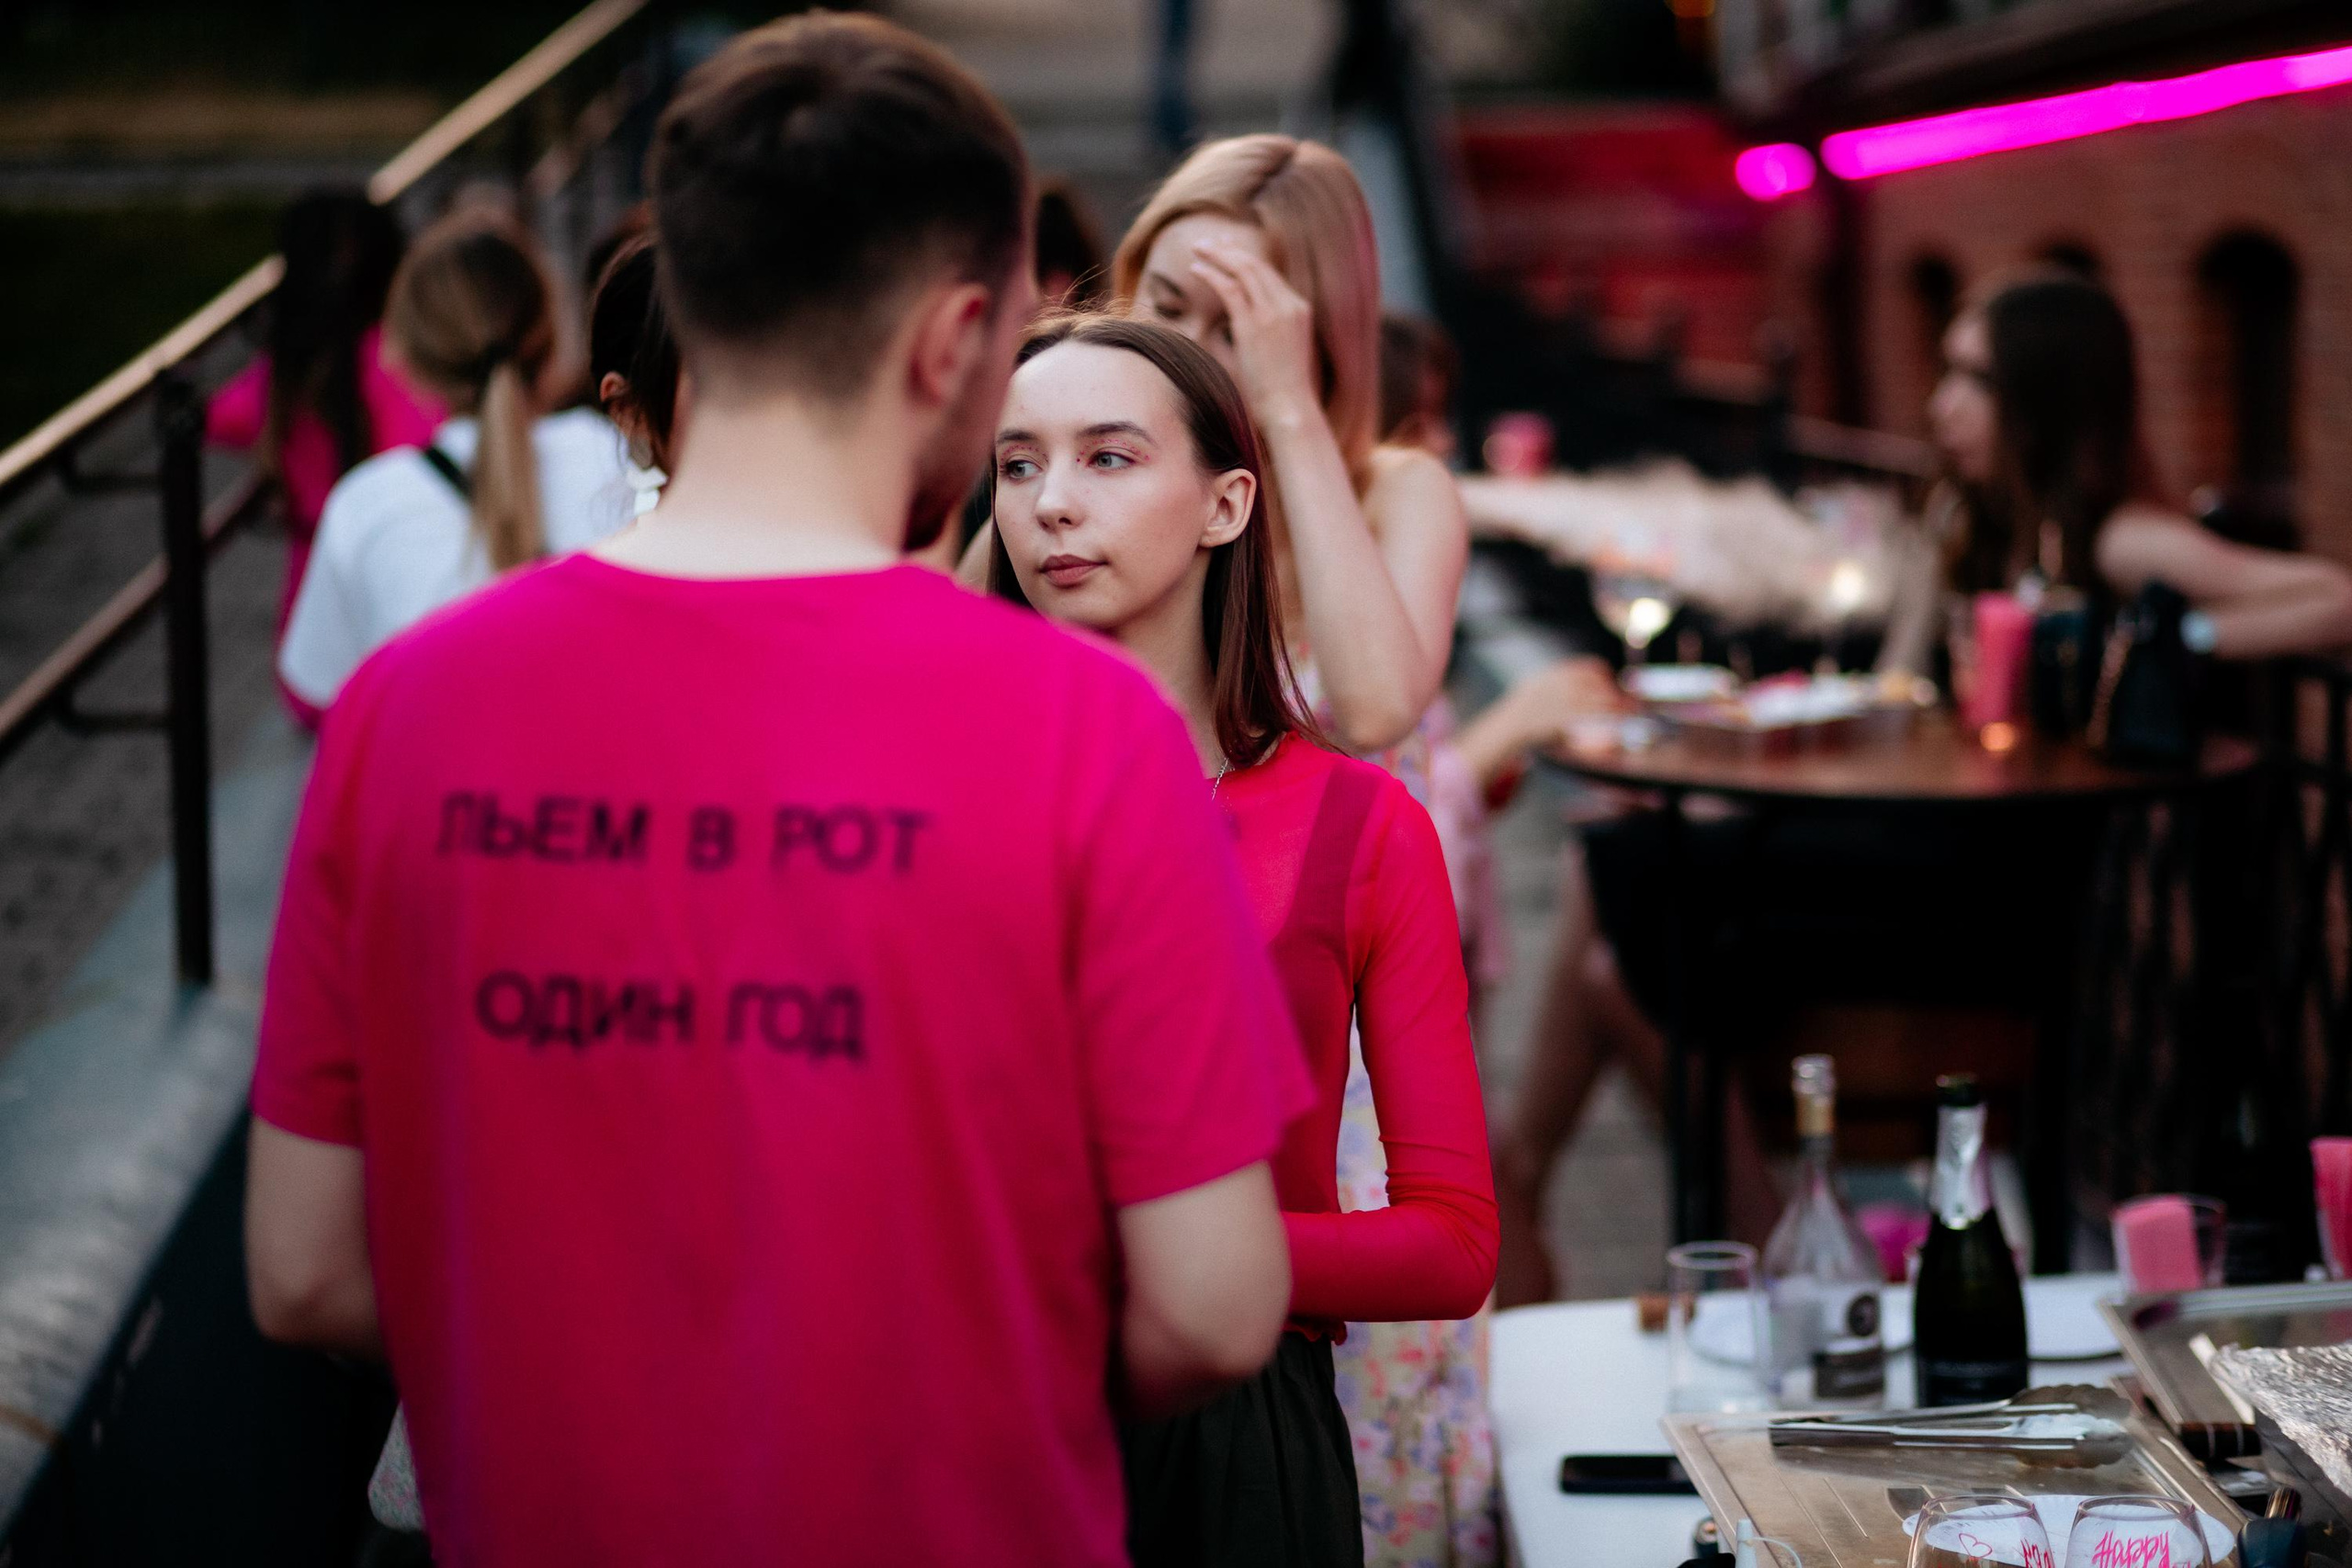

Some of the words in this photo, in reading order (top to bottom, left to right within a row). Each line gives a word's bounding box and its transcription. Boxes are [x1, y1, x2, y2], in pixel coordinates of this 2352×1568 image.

[688, 805, 738, 873] В
[772, 805, 935, 875] РОТ
[475, 970, 695, 1056] ОДИН
[727, 982, 866, 1068] ГОД
[2091, 1529, 2170, 1568] Happy
